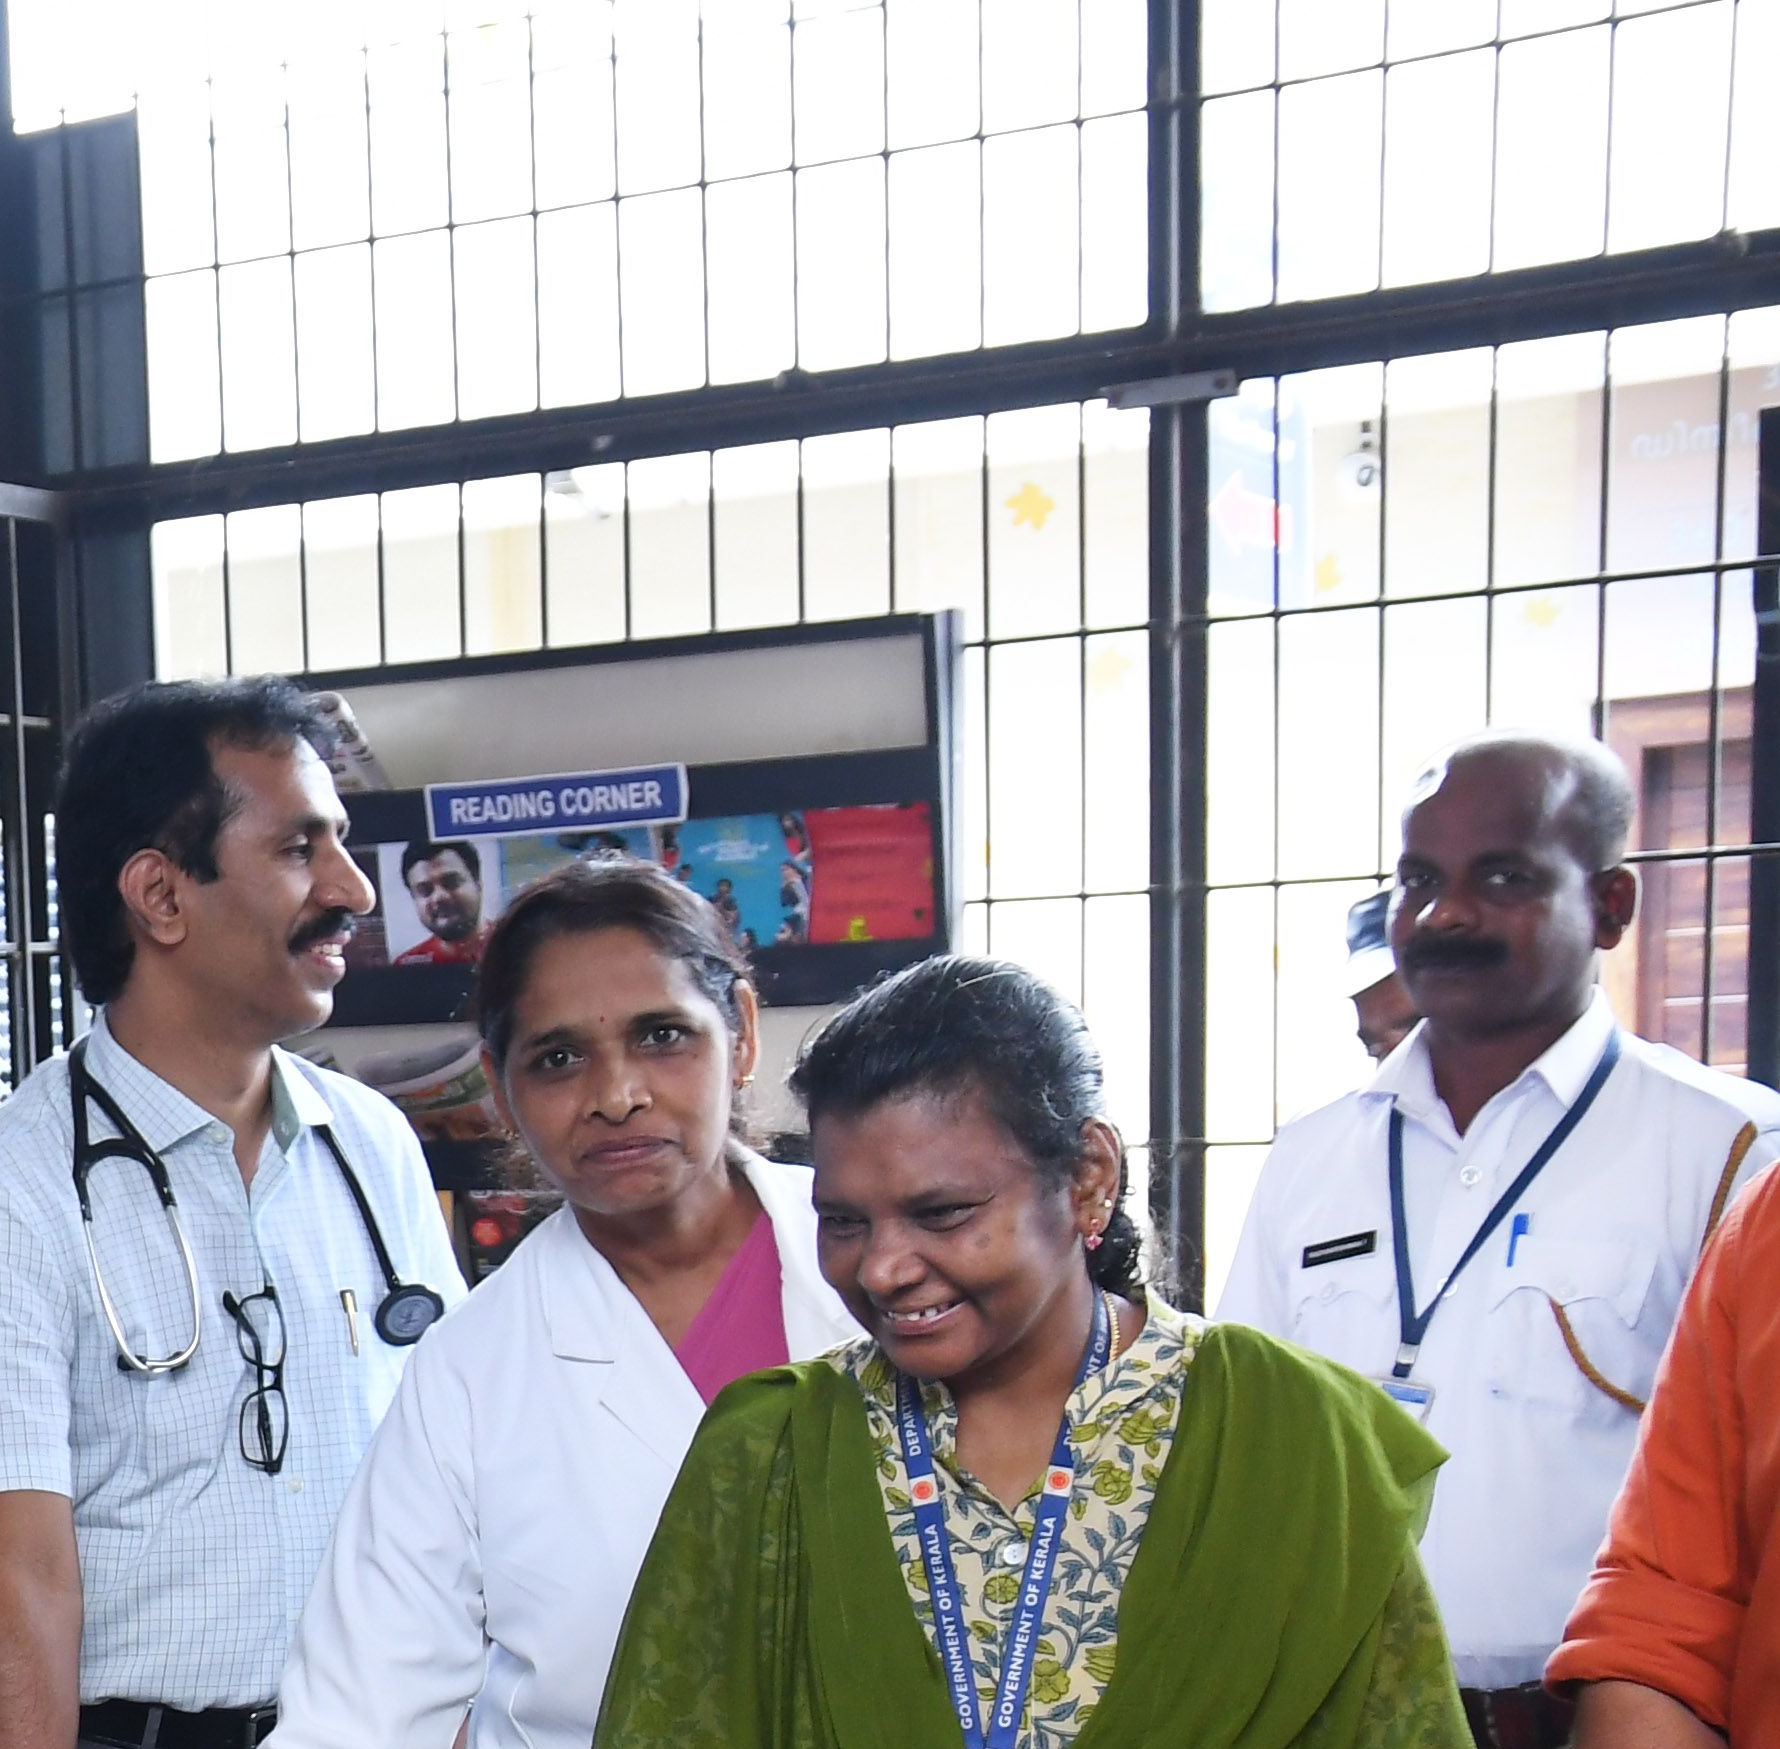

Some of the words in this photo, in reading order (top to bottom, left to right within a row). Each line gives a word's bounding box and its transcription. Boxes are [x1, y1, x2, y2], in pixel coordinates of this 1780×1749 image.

[450, 790, 554, 826] READING
[560, 780, 662, 818] CORNER
[924, 1523, 949, 1585] KERALA
[1030, 1516, 1057, 1581] KERALA
[937, 1589, 952, 1611] OF
[1024, 1583, 1040, 1607] OF
[941, 1614, 973, 1730] GOVERNMENT
[998, 1609, 1035, 1728] GOVERNMENT
